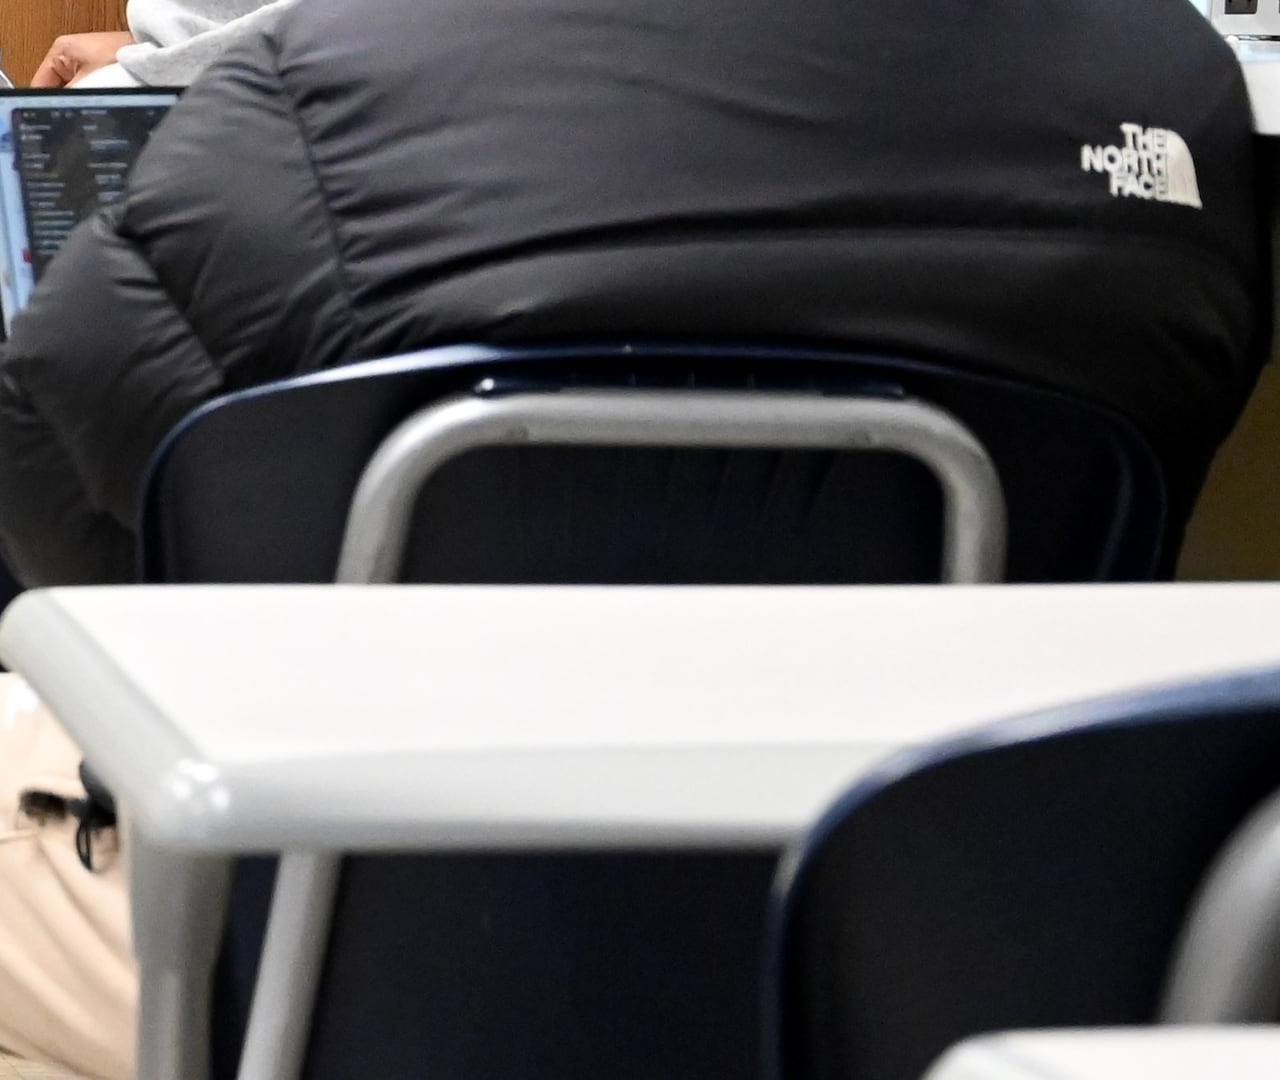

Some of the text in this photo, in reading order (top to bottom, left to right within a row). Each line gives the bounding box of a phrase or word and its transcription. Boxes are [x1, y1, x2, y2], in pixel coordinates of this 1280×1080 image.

[1120, 122, 1168, 149] THE
[1081, 144, 1168, 177] NORTH
[1109, 171, 1169, 201] FACE
